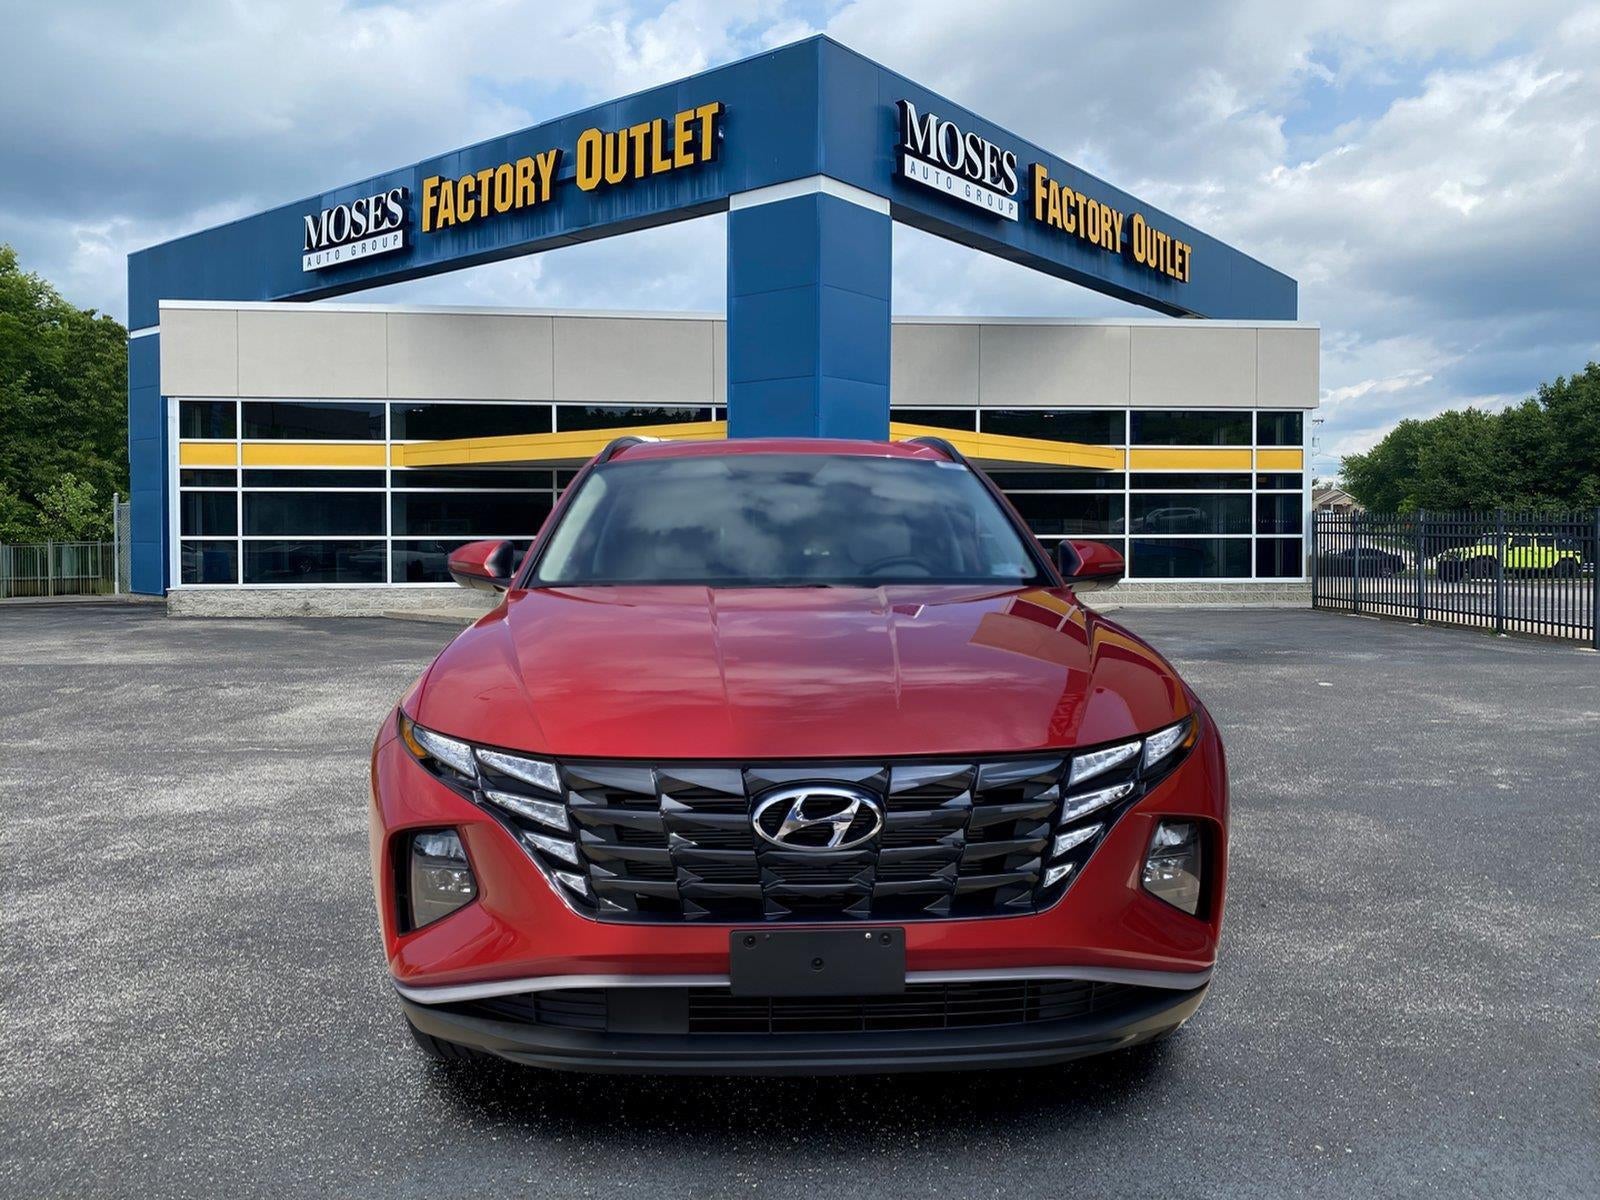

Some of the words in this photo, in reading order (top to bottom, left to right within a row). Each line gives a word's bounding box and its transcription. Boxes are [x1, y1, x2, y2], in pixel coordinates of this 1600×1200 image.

[422, 148, 558, 233] FACTORY
[576, 101, 720, 192] OUTLET
[904, 99, 1018, 196] MOSES
[909, 161, 953, 190] AUTO
[965, 184, 1014, 214] GROUP
[303, 188, 403, 251] MOSES
[307, 247, 340, 267] AUTO
[350, 234, 399, 256] GROUP
[1034, 162, 1124, 253] FACTORY
[1131, 213, 1192, 283] OUTLET
